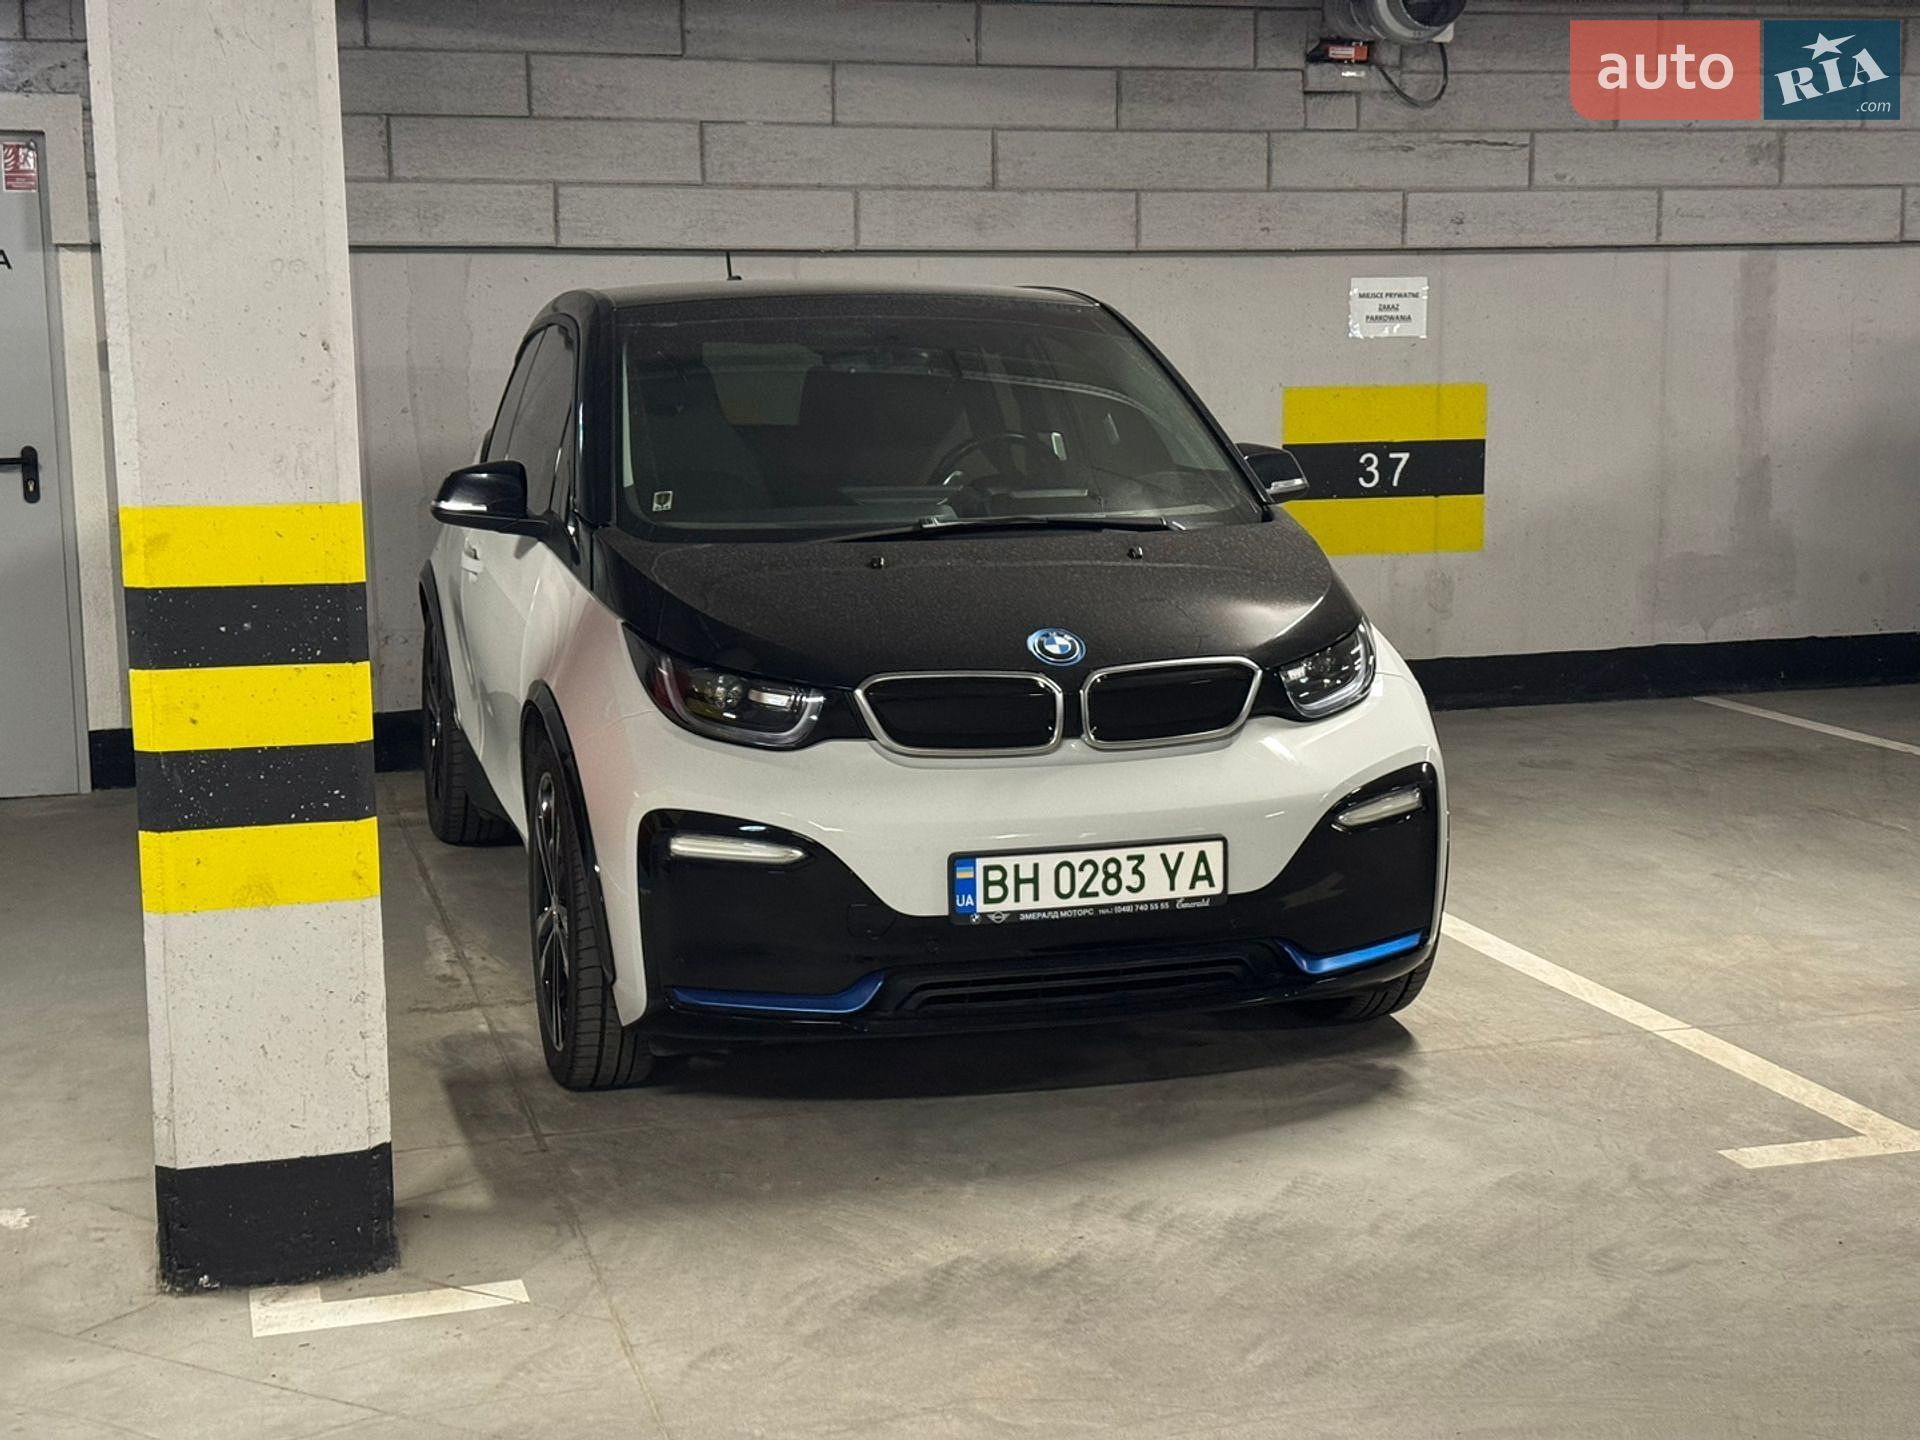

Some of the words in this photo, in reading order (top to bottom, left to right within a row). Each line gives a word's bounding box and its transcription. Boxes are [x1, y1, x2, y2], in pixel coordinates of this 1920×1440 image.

[1385, 291, 1420, 299] PRYWATNE
[1378, 303, 1400, 311] ZAKAZ
[1365, 314, 1412, 322] PARKOWANIA
[1358, 452, 1411, 488] 37
[982, 863, 1040, 905] BH
[1054, 854, 1146, 900] 0283
[1159, 850, 1216, 892] YA
[955, 895, 975, 908] UA
